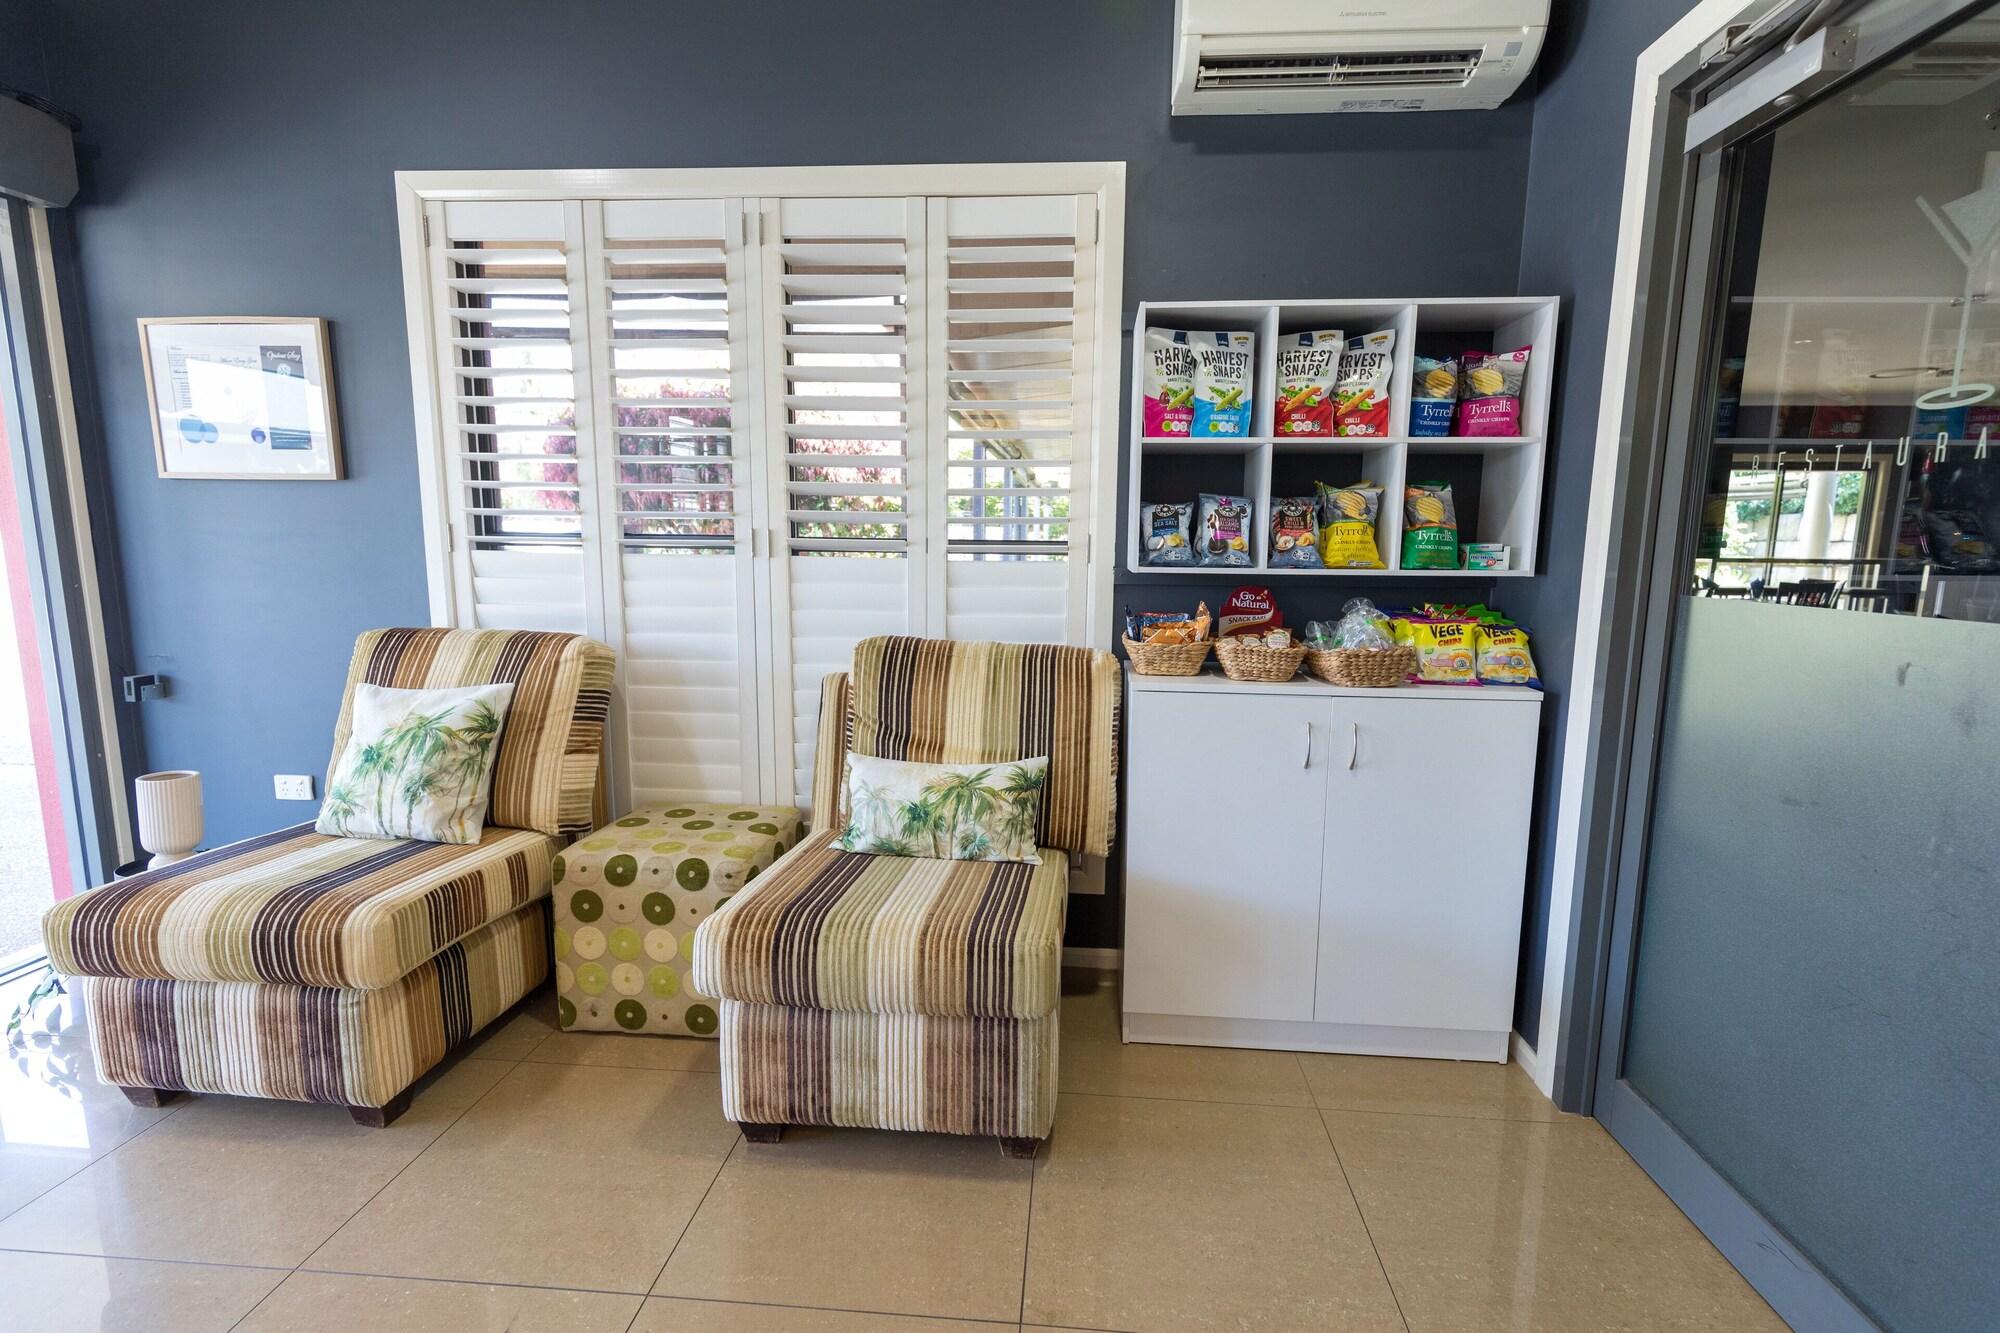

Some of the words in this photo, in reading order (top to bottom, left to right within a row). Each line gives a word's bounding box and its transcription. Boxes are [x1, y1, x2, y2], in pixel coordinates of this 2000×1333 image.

[1201, 350, 1249, 369] HARVEST
[1277, 349, 1333, 368] HARVEST
[1339, 352, 1386, 369] ARVEST
[1165, 363, 1193, 378] SNAPS
[1213, 364, 1242, 379] SNAPS
[1285, 363, 1321, 376] SNAPS
[1337, 367, 1373, 382] SNAPS
[1420, 404, 1454, 421] Tyrrel
[1751, 427, 1988, 478] RESTAURA
[1240, 591, 1255, 600] Go
[1232, 598, 1270, 609] Natural
[1228, 616, 1251, 624] SNACK
[1429, 624, 1464, 639] VEGE
[1481, 628, 1516, 639] VEGE
